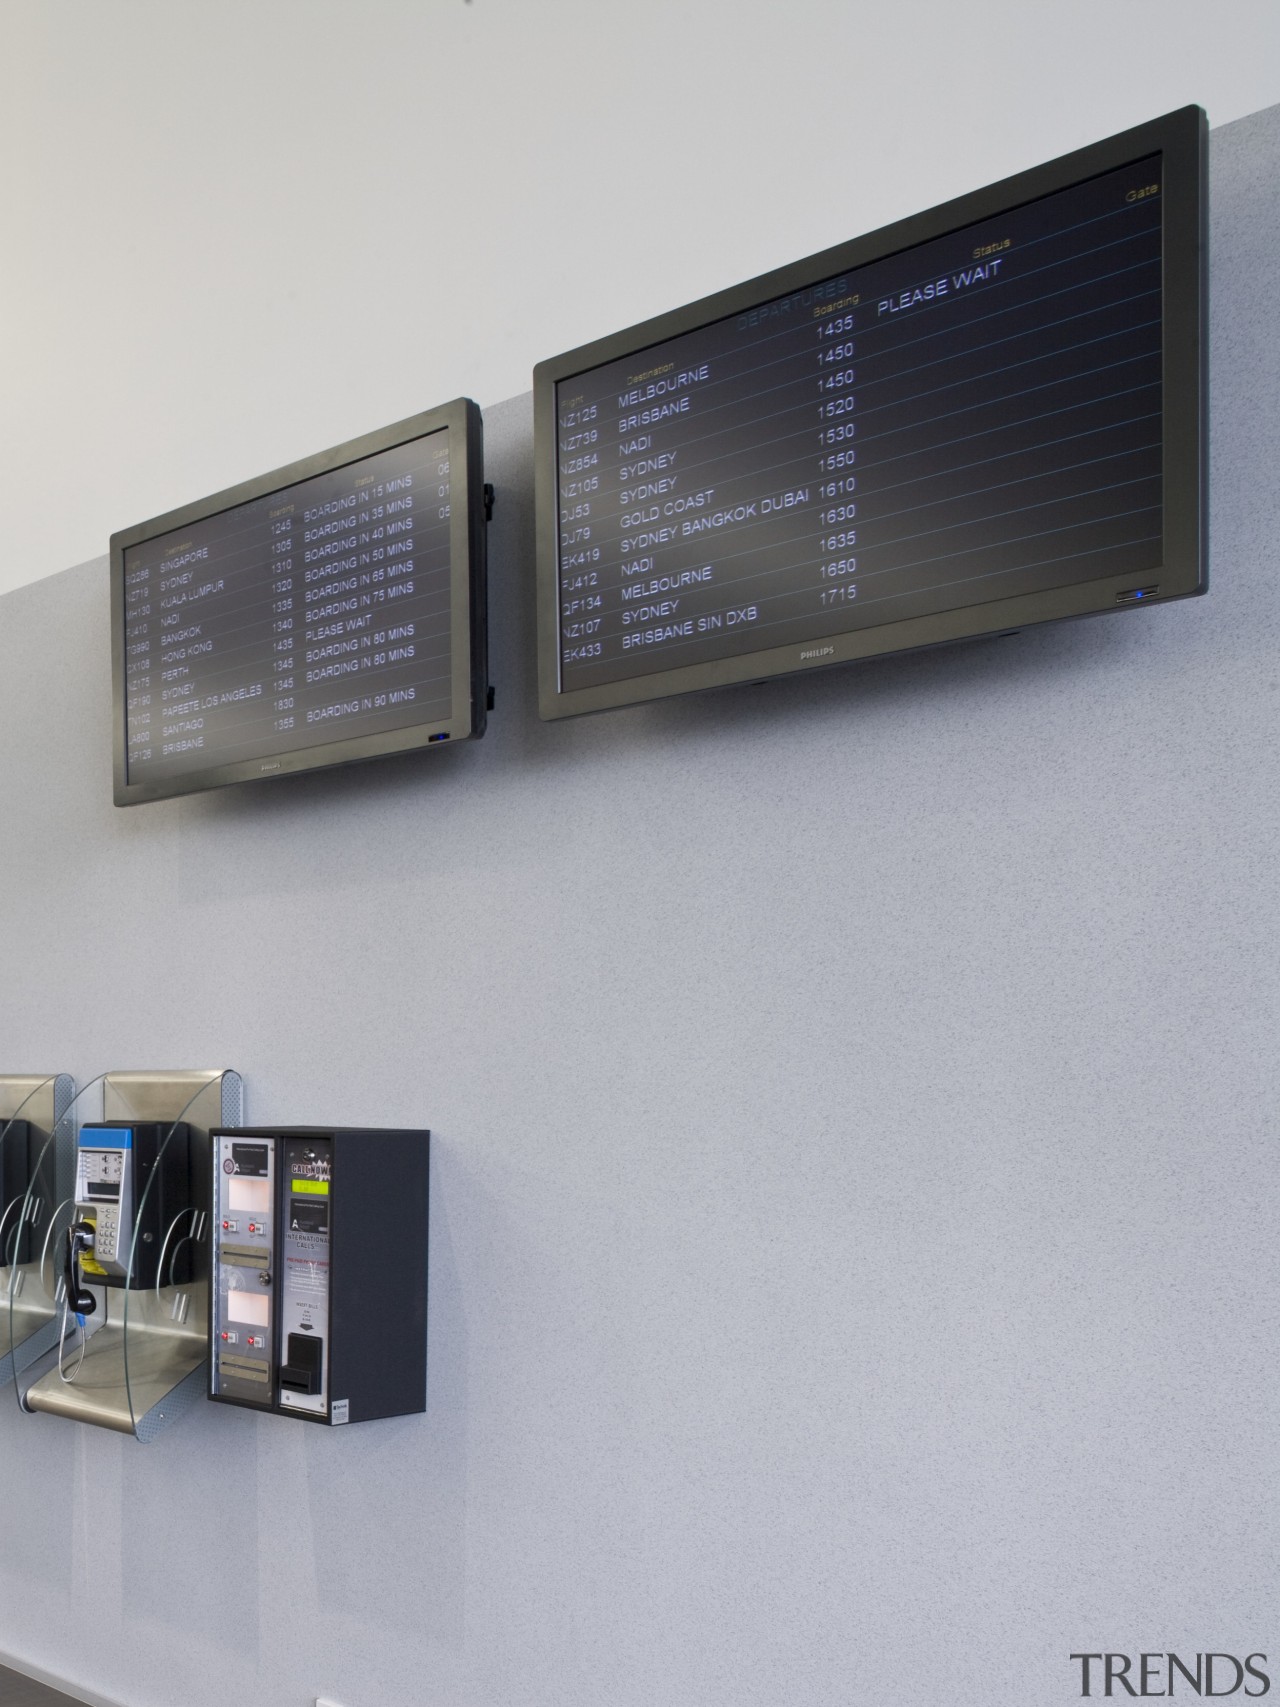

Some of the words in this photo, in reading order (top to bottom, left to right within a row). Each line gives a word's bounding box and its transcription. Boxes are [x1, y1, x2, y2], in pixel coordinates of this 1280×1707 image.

[627, 362, 675, 386] Destination
[813, 294, 860, 318] Boarding
[972, 239, 1011, 259] Status
[1125, 184, 1158, 202] Gate
[618, 365, 709, 408] MELBOURNE
[816, 315, 854, 340] 1435
[878, 279, 948, 316] PLEASE
[952, 258, 1003, 290] WAIT
[619, 397, 690, 433] BRISBANE
[816, 342, 854, 366] 1450
[619, 435, 651, 457] NADI
[817, 369, 854, 393] 1450
[620, 451, 677, 480] SYDNEY
[817, 396, 855, 419] 1520
[620, 476, 677, 504] SYDNEY
[818, 423, 855, 446] 1530
[160, 547, 209, 573] SINGAPORE
[271, 519, 291, 535] 1245
[304, 495, 356, 522] BOARDING
[359, 490, 369, 503] IN
[372, 485, 383, 498] 15
[386, 475, 412, 493] MINS
[620, 506, 660, 528] GOLD
[664, 490, 715, 516] COAST
[818, 450, 855, 473] 1550
[620, 526, 678, 553] SYDNEY
[682, 503, 757, 536] BANGKOK
[761, 488, 809, 514] DUBAI
[819, 477, 855, 499] 1610
[160, 571, 193, 591] SYDNEY
[272, 539, 292, 554] 1305
[304, 516, 356, 542] BOARDING
[359, 511, 369, 524] IN
[372, 506, 383, 519] 35
[386, 496, 412, 515] MINS
[160, 593, 186, 609] KUALA
[189, 580, 225, 601] LUMPUR
[272, 559, 292, 574] 1310
[305, 536, 357, 562] BOARDING
[360, 532, 369, 545] IN
[372, 527, 383, 540] 40
[387, 518, 413, 536] MINS
[621, 557, 653, 577] NADI
[819, 504, 856, 526] 1630
[621, 566, 713, 601] MELBOURNE
[819, 531, 856, 552] 1635
[161, 612, 180, 627] NADI
[272, 578, 292, 593] 1320
[305, 557, 357, 583] BOARDING
[360, 553, 369, 566] IN
[372, 548, 384, 561] 50
[387, 539, 413, 557] MINS
[161, 624, 201, 646] BANGKOK
[272, 598, 293, 614] 1335
[305, 577, 357, 602] BOARDING
[360, 573, 370, 586] IN
[373, 569, 384, 582] 65
[387, 560, 414, 577] MINS
[161, 648, 186, 663] HONG
[187, 640, 213, 656] KONG
[272, 618, 293, 633] 1340
[306, 598, 357, 623] BOARDING
[360, 595, 370, 607] IN
[373, 589, 384, 603] 75
[387, 581, 414, 599] MINS
[622, 600, 679, 625] SYDNEY
[820, 558, 856, 579] 1650
[622, 621, 693, 649] BRISBANE
[697, 615, 722, 632] SIN
[726, 606, 757, 625] DXB
[820, 584, 857, 605] 1715
[161, 666, 189, 681] PERTH
[273, 637, 293, 652] 1435
[306, 622, 344, 642] PLEASE
[346, 614, 372, 631] WAIT
[162, 682, 195, 700] SYDNEY
[273, 657, 294, 672] 1345
[306, 639, 358, 663] BOARDING
[361, 636, 371, 648] IN
[373, 632, 385, 644] 80
[388, 624, 414, 641] MINS
[162, 700, 199, 717] PAPEETE
[201, 695, 218, 709] LOS
[220, 684, 262, 703] ANGELES
[273, 677, 294, 692] 1345
[306, 660, 358, 682] BOARDING
[361, 657, 371, 669] IN
[374, 653, 385, 665] 80
[389, 645, 415, 662] MINS
[801, 646, 834, 660] PHILIPS
[162, 718, 203, 737] SANTIAGO
[274, 697, 294, 711] 1830
[162, 736, 204, 755] BRISBANE
[307, 701, 359, 723] BOARDING
[361, 698, 371, 710] IN
[374, 695, 386, 707] 90
[389, 688, 415, 704] MINS
[292, 1164, 311, 1175] CALL
